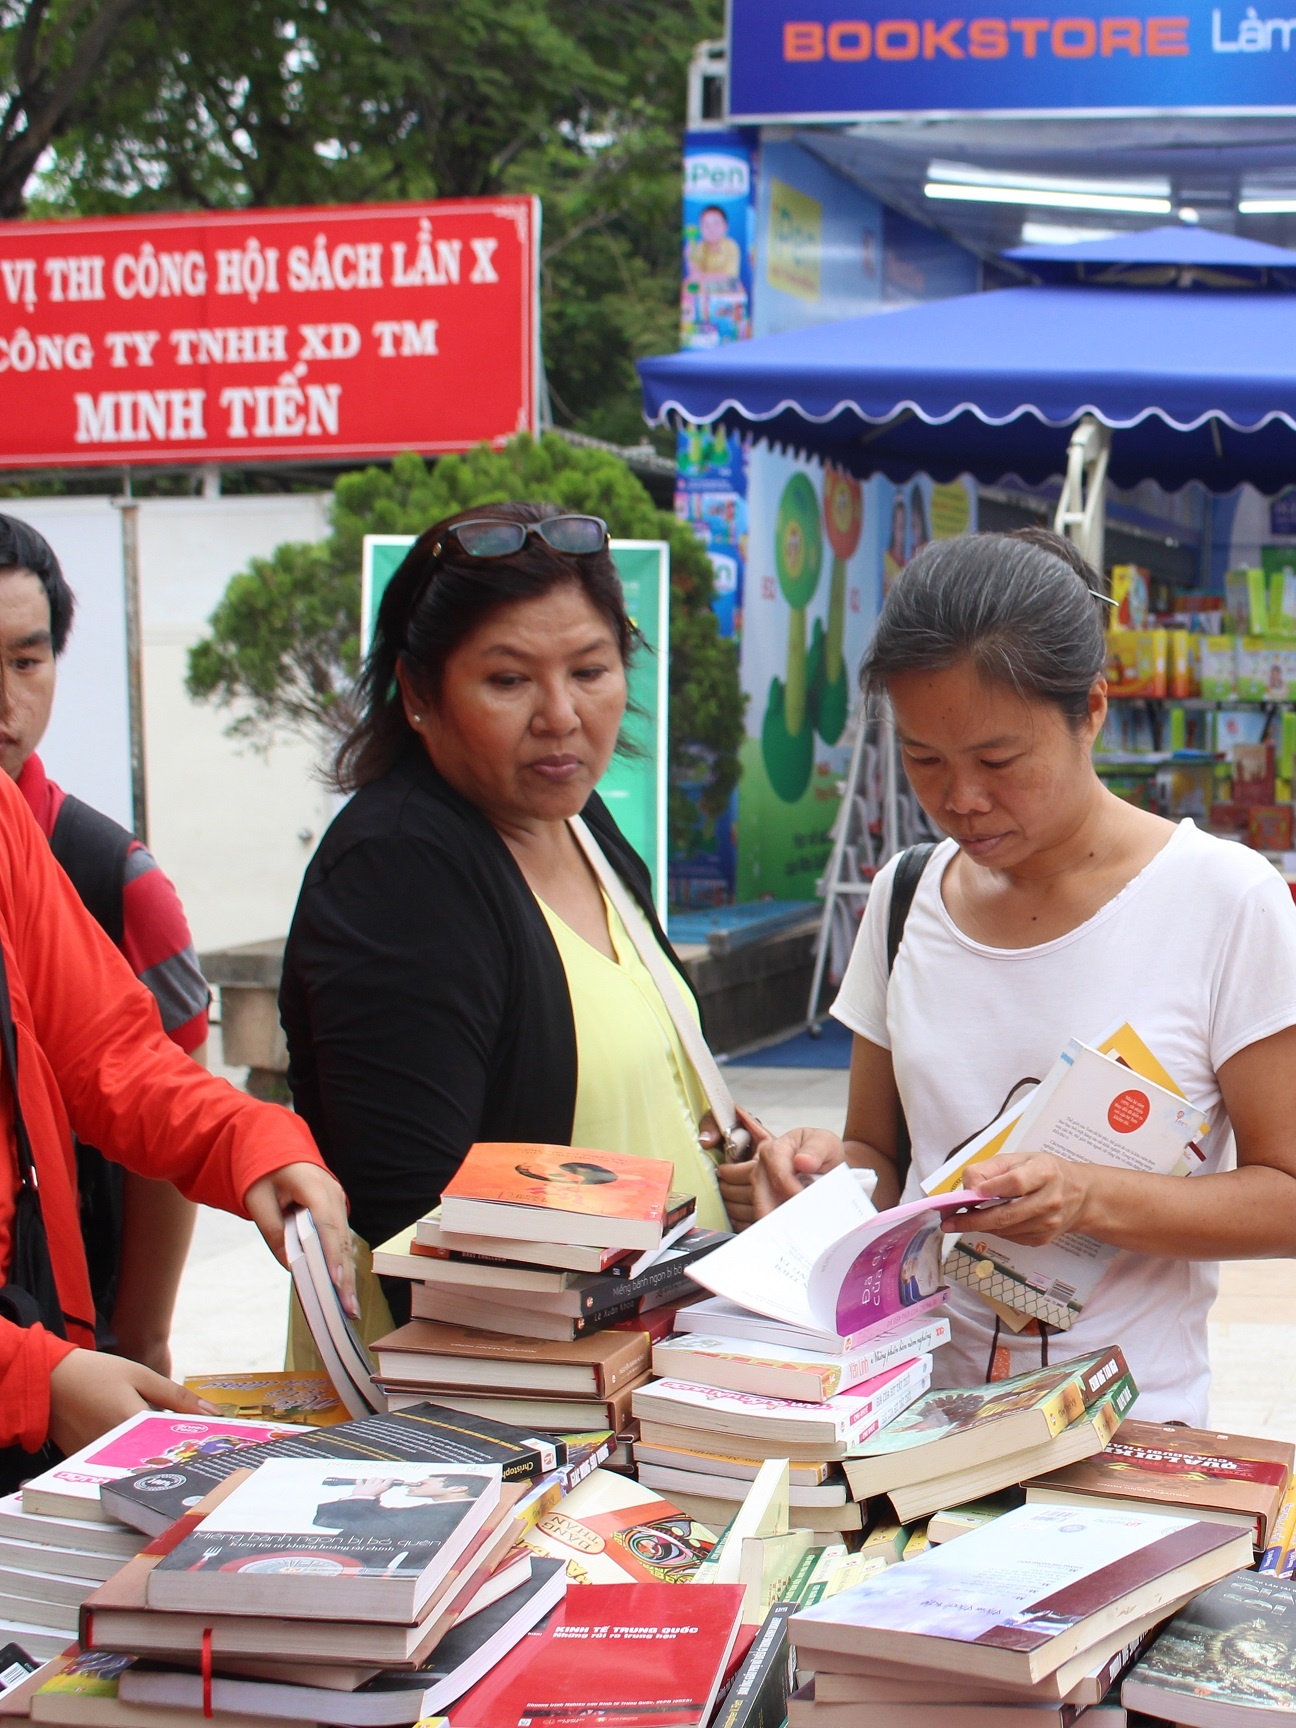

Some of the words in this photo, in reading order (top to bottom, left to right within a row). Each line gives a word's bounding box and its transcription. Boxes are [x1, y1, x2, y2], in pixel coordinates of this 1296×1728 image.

[783, 16, 1190, 62] BOOKSTORE
[1, 261, 36, 313] VỊ
[44, 257, 104, 303] THI
[112, 242, 207, 299] CÔNG
[216, 236, 280, 303] HỘI
[287, 233, 383, 292] SÁCH
[391, 217, 463, 288] LẦN
[470, 237, 498, 285] X
[0, 327, 94, 373] CÔNG
[104, 330, 161, 367] TY
[169, 326, 288, 366] TNHH
[298, 322, 361, 361] XD
[372, 319, 439, 358] TM
[75, 388, 207, 443] MINH
[220, 362, 341, 439] TIẾN
